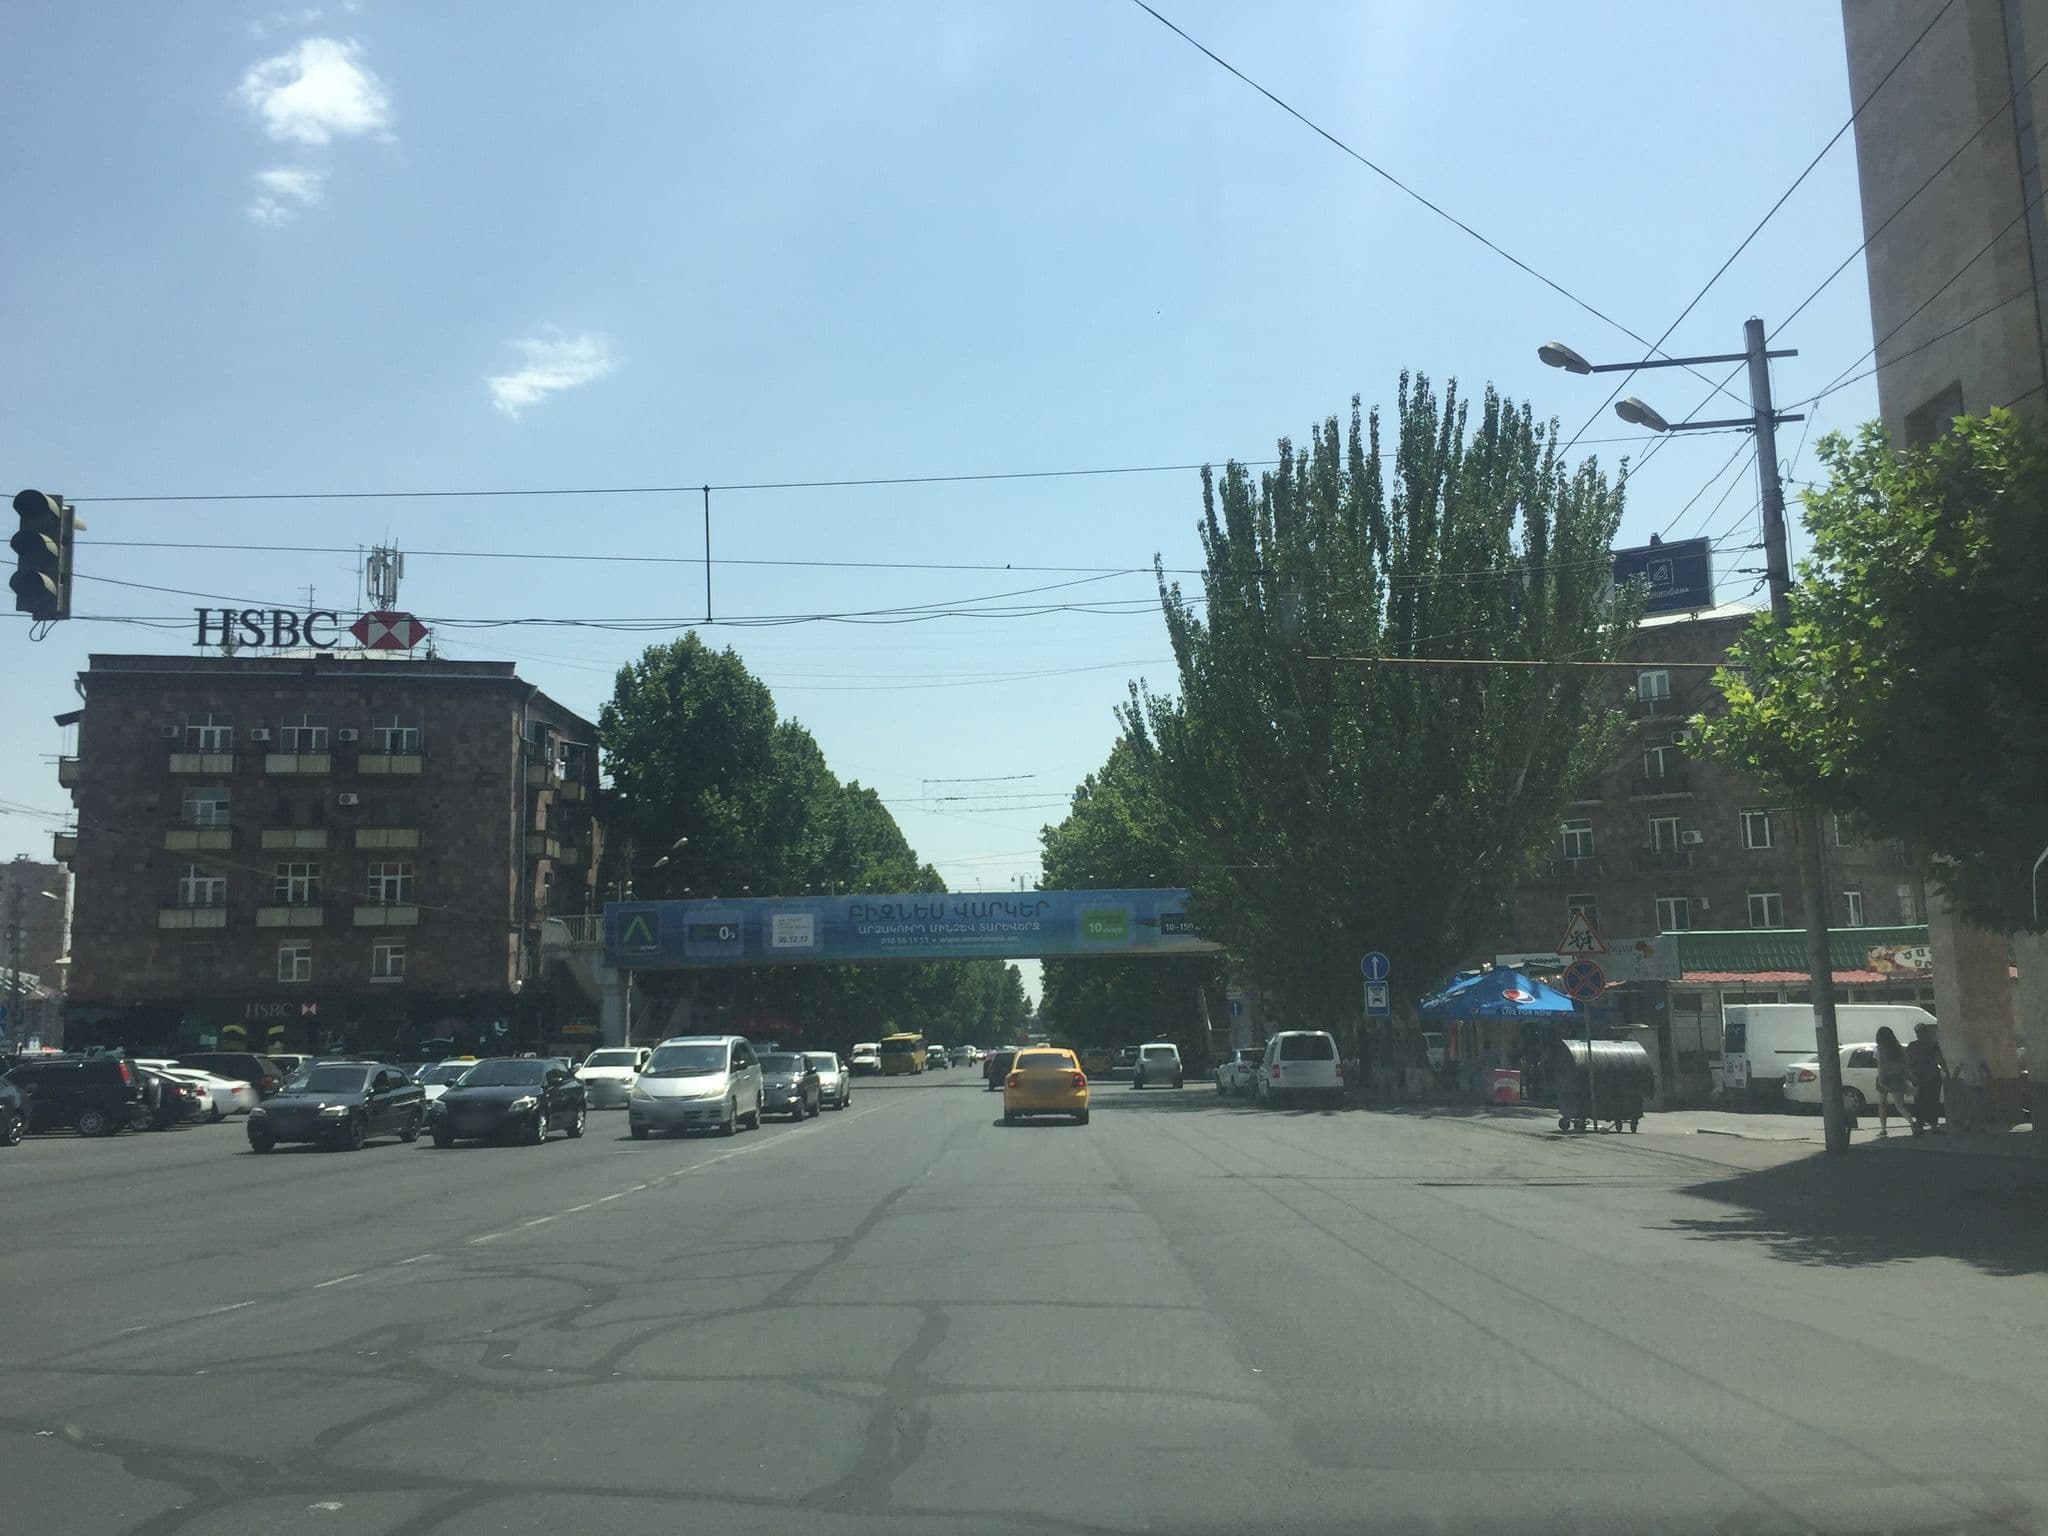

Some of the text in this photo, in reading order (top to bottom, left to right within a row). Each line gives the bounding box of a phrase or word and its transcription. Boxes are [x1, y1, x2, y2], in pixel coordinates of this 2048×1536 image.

[193, 608, 338, 649] HSBC
[848, 900, 1050, 920] ԲԻԶՆԵՍ ՎԱՐԿԵՐ
[1088, 922, 1103, 933] 10
[246, 1003, 292, 1018] HSBC
[1501, 1008, 1552, 1017] LIVE FOR NOW
